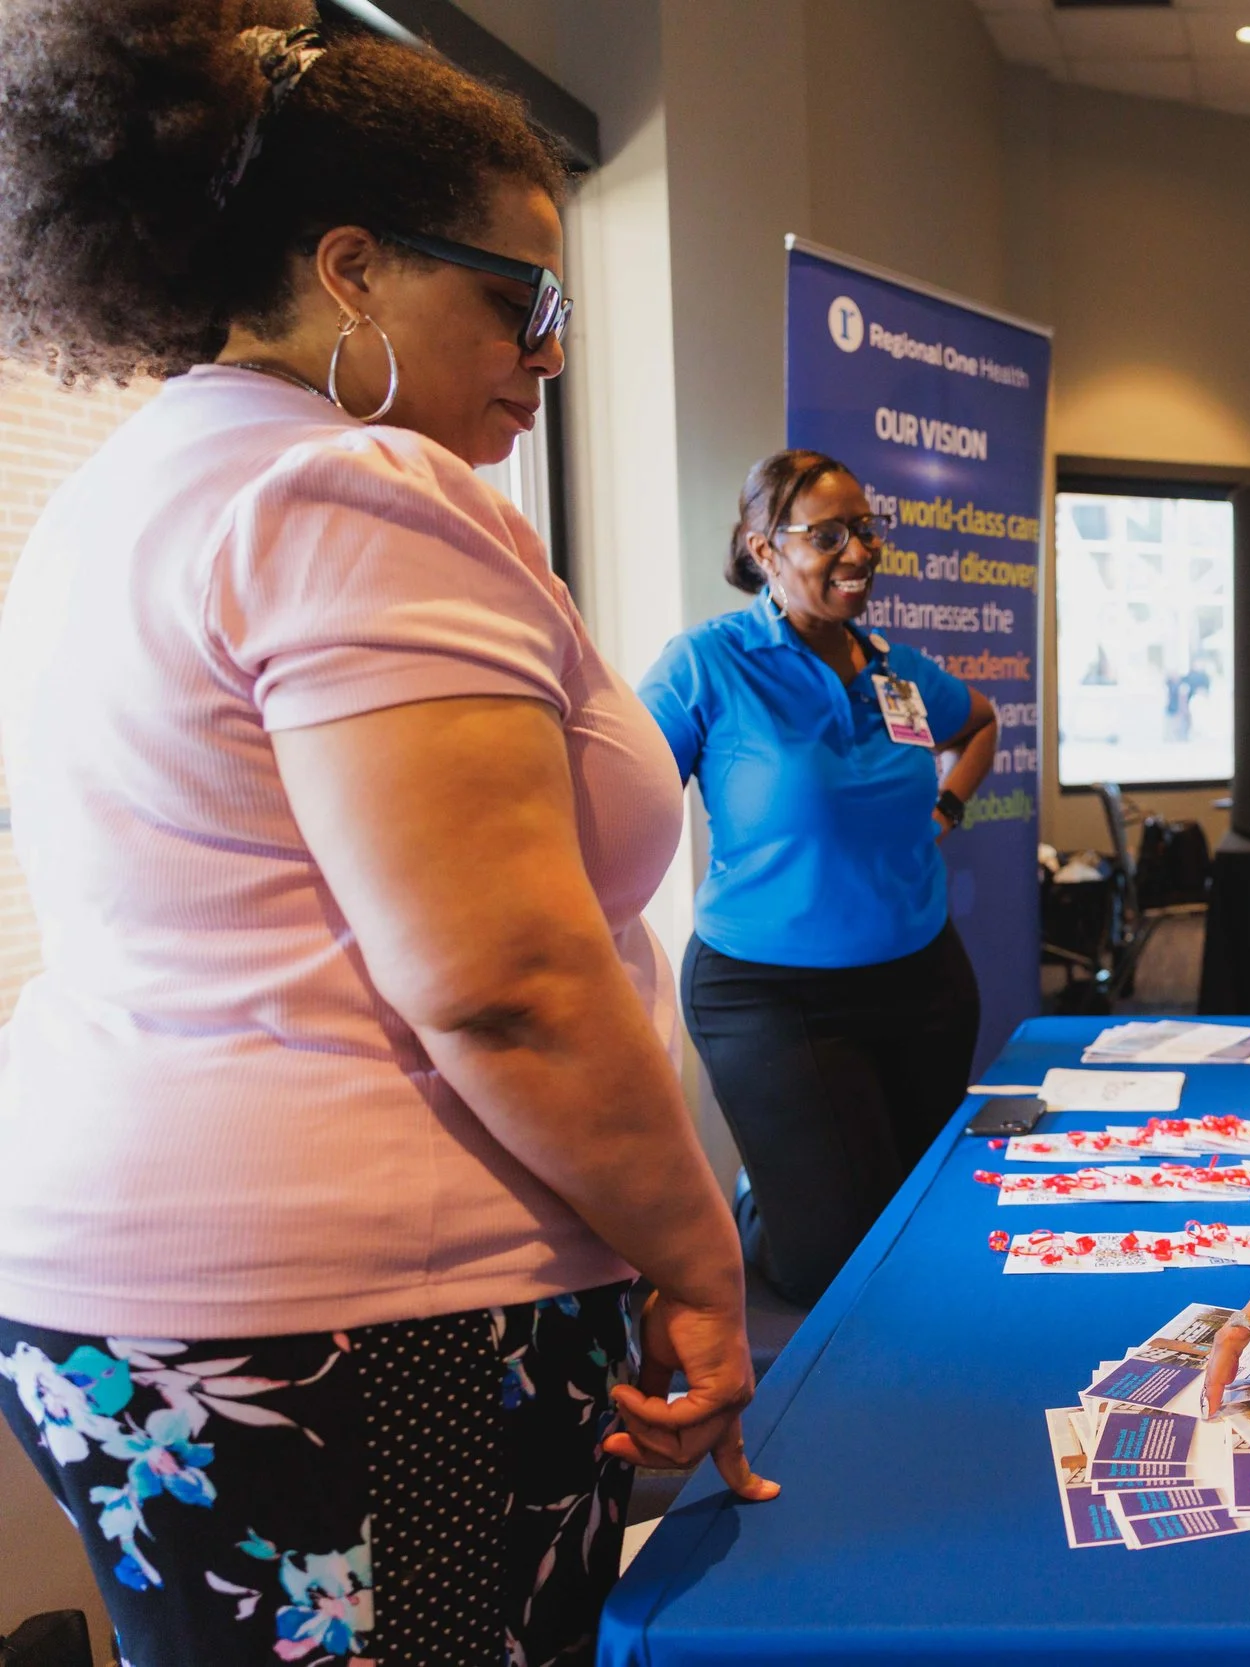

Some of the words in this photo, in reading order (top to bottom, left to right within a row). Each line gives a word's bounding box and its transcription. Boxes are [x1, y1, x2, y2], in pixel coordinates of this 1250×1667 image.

[869, 322, 942, 366] Regional
[943, 346, 978, 377] One
[978, 355, 1030, 390] Health
[875, 406, 919, 447] OUR
[919, 415, 988, 461] VISION
[864, 483, 897, 530] ing
[899, 496, 1006, 538] world-class
[875, 542, 924, 582] tion,
[925, 548, 959, 582] and
[893, 593, 981, 633] harnesses
[982, 600, 1014, 634] the
[948, 648, 1032, 682] academic
